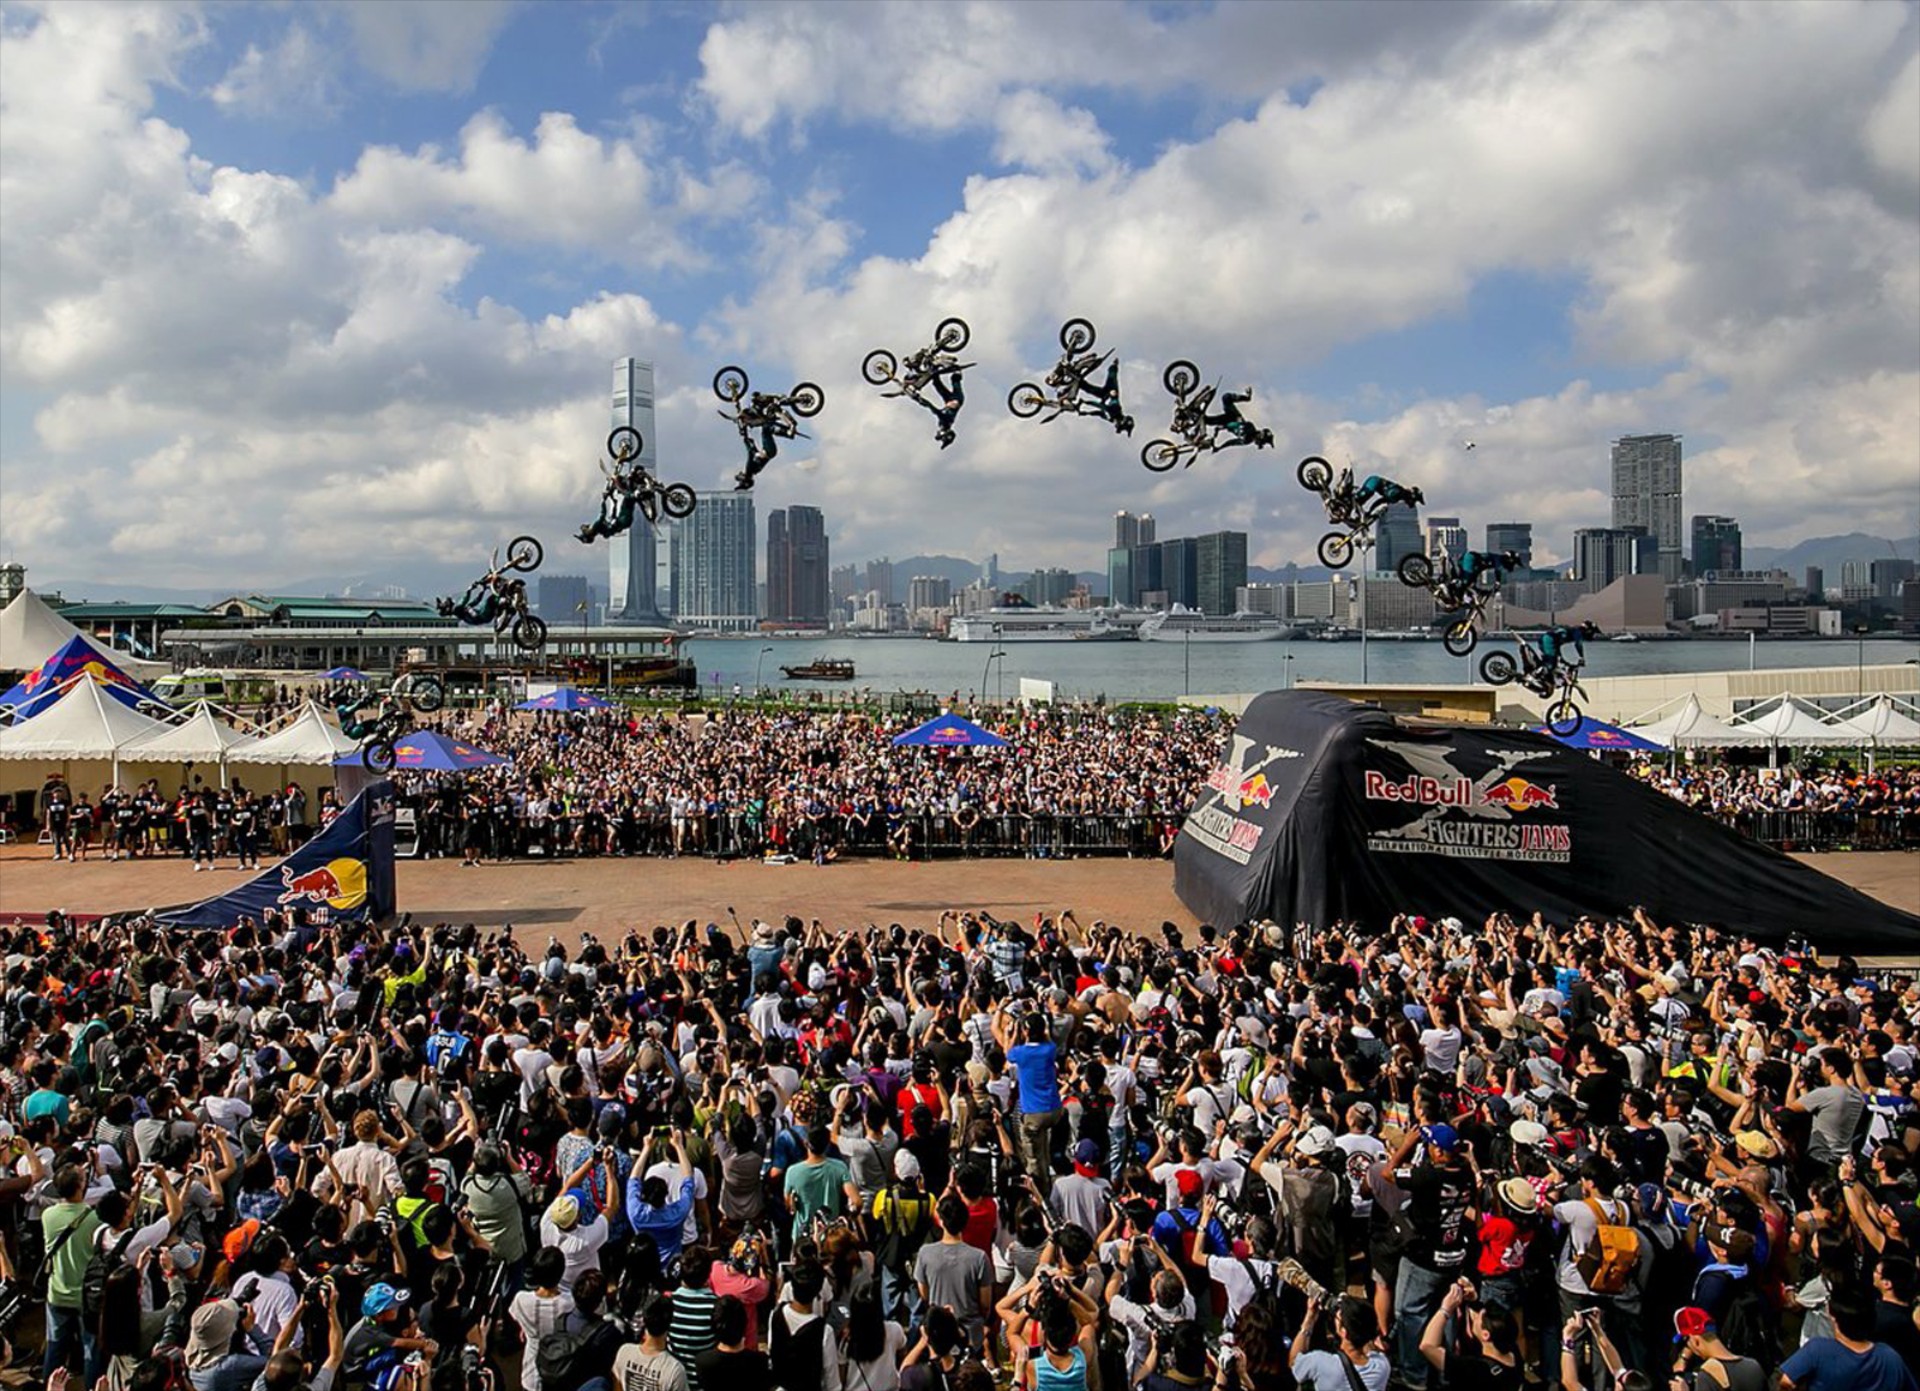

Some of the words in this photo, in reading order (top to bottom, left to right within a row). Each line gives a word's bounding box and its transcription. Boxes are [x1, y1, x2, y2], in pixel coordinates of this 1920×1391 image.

[1366, 771, 1417, 802] Red
[1419, 777, 1472, 807] Bull
[1426, 819, 1520, 849] FIGHTERS
[1520, 825, 1572, 851] JAMS
[1506, 849, 1569, 860] MOTOCROSS
